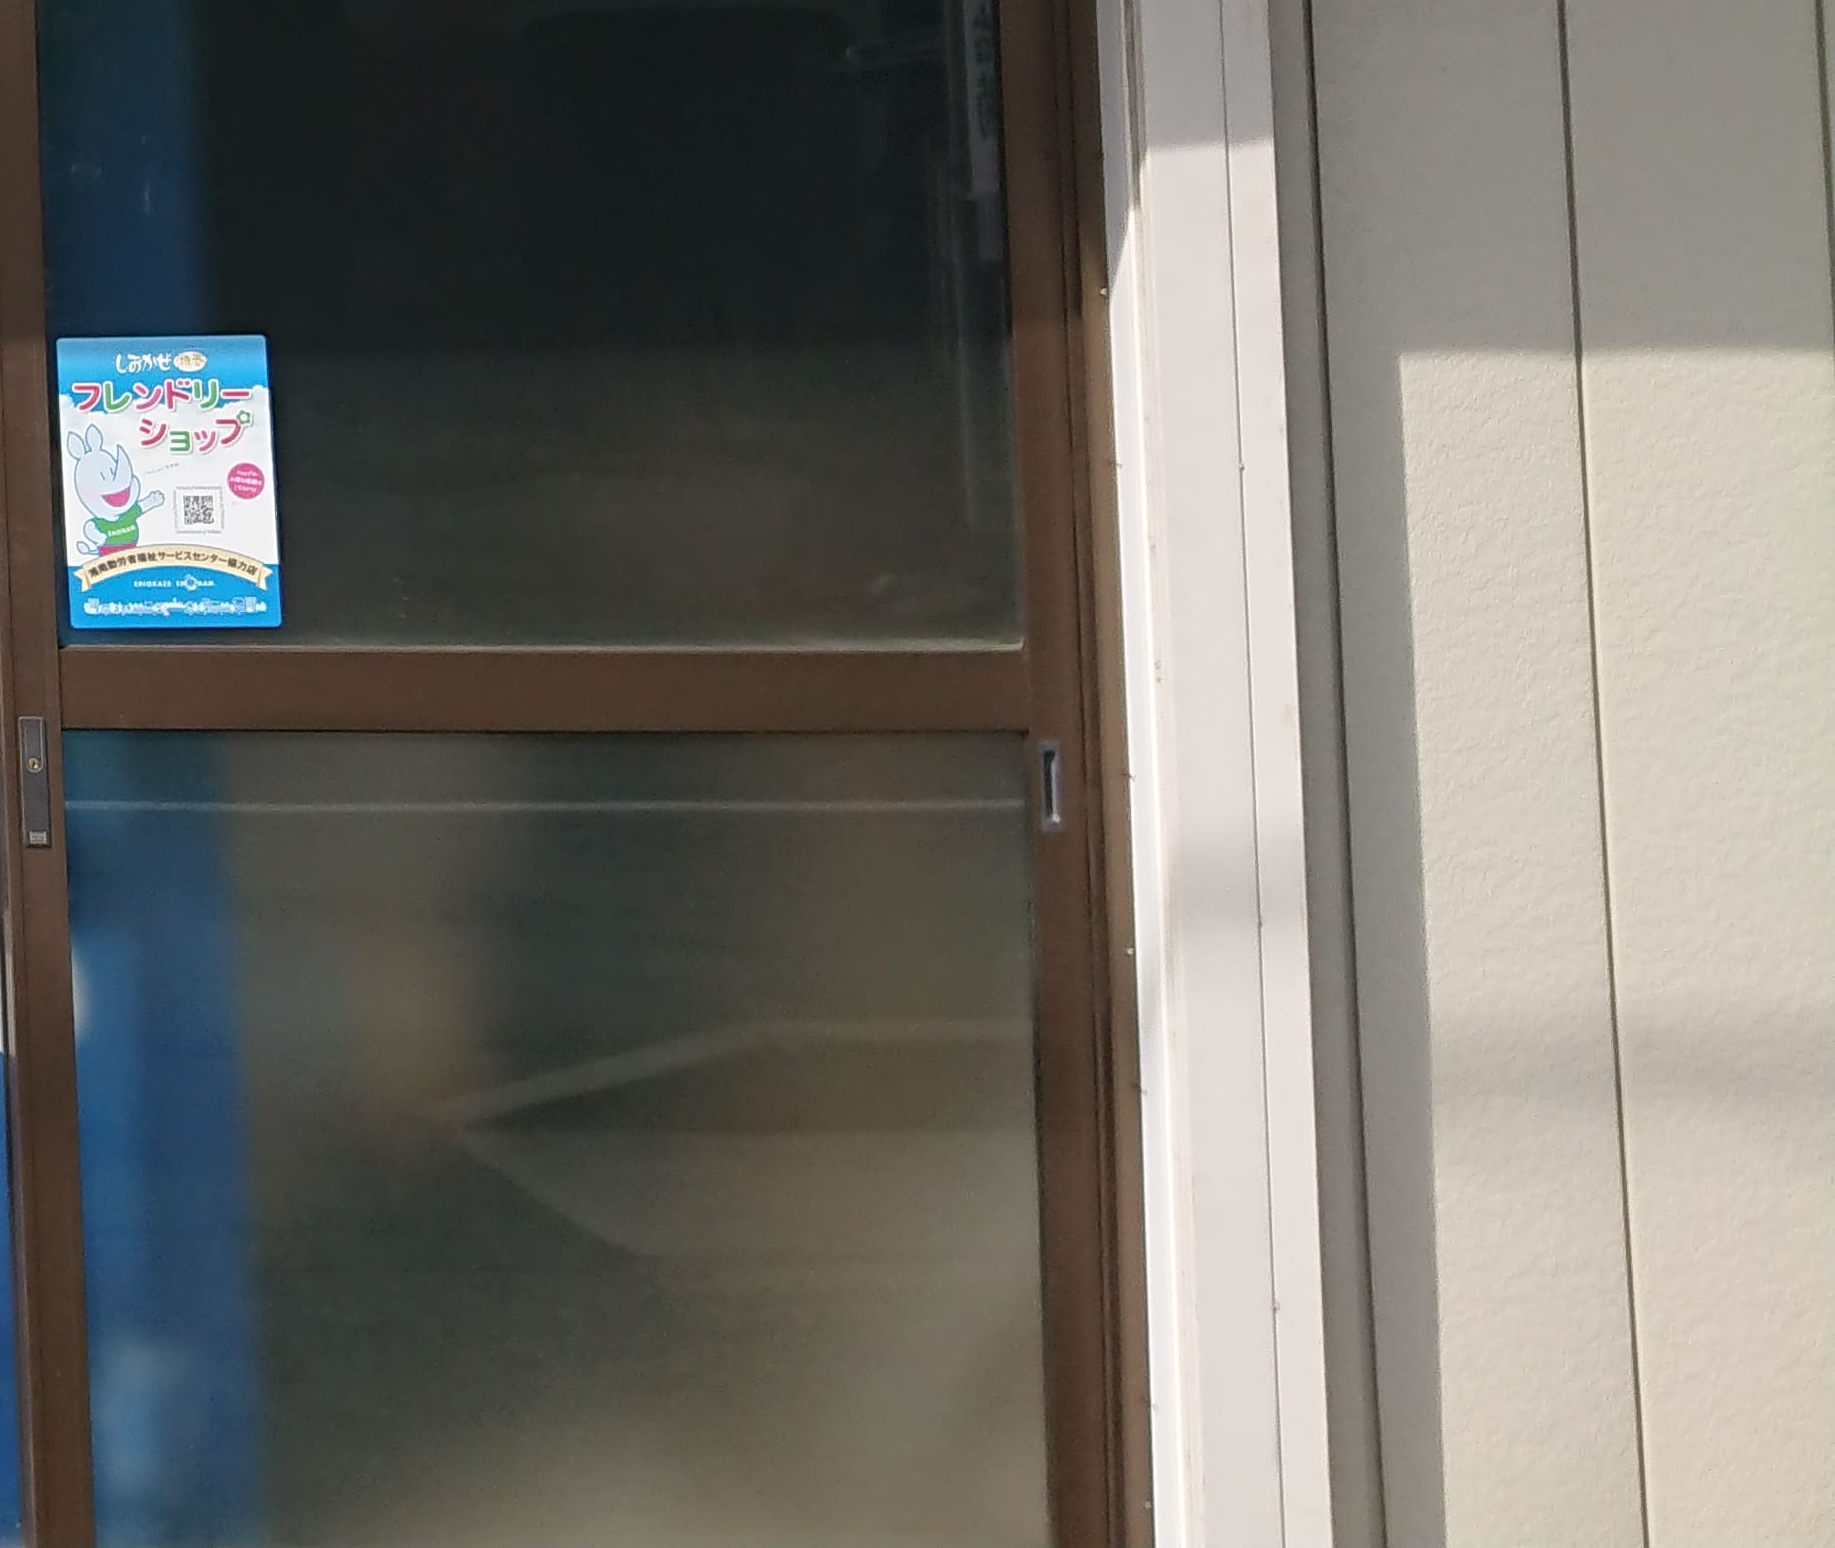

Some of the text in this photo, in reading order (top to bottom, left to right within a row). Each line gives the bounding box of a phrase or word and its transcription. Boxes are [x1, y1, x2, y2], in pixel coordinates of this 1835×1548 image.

[72, 378, 252, 413] フレンドリー
[138, 410, 253, 454] ショップ
